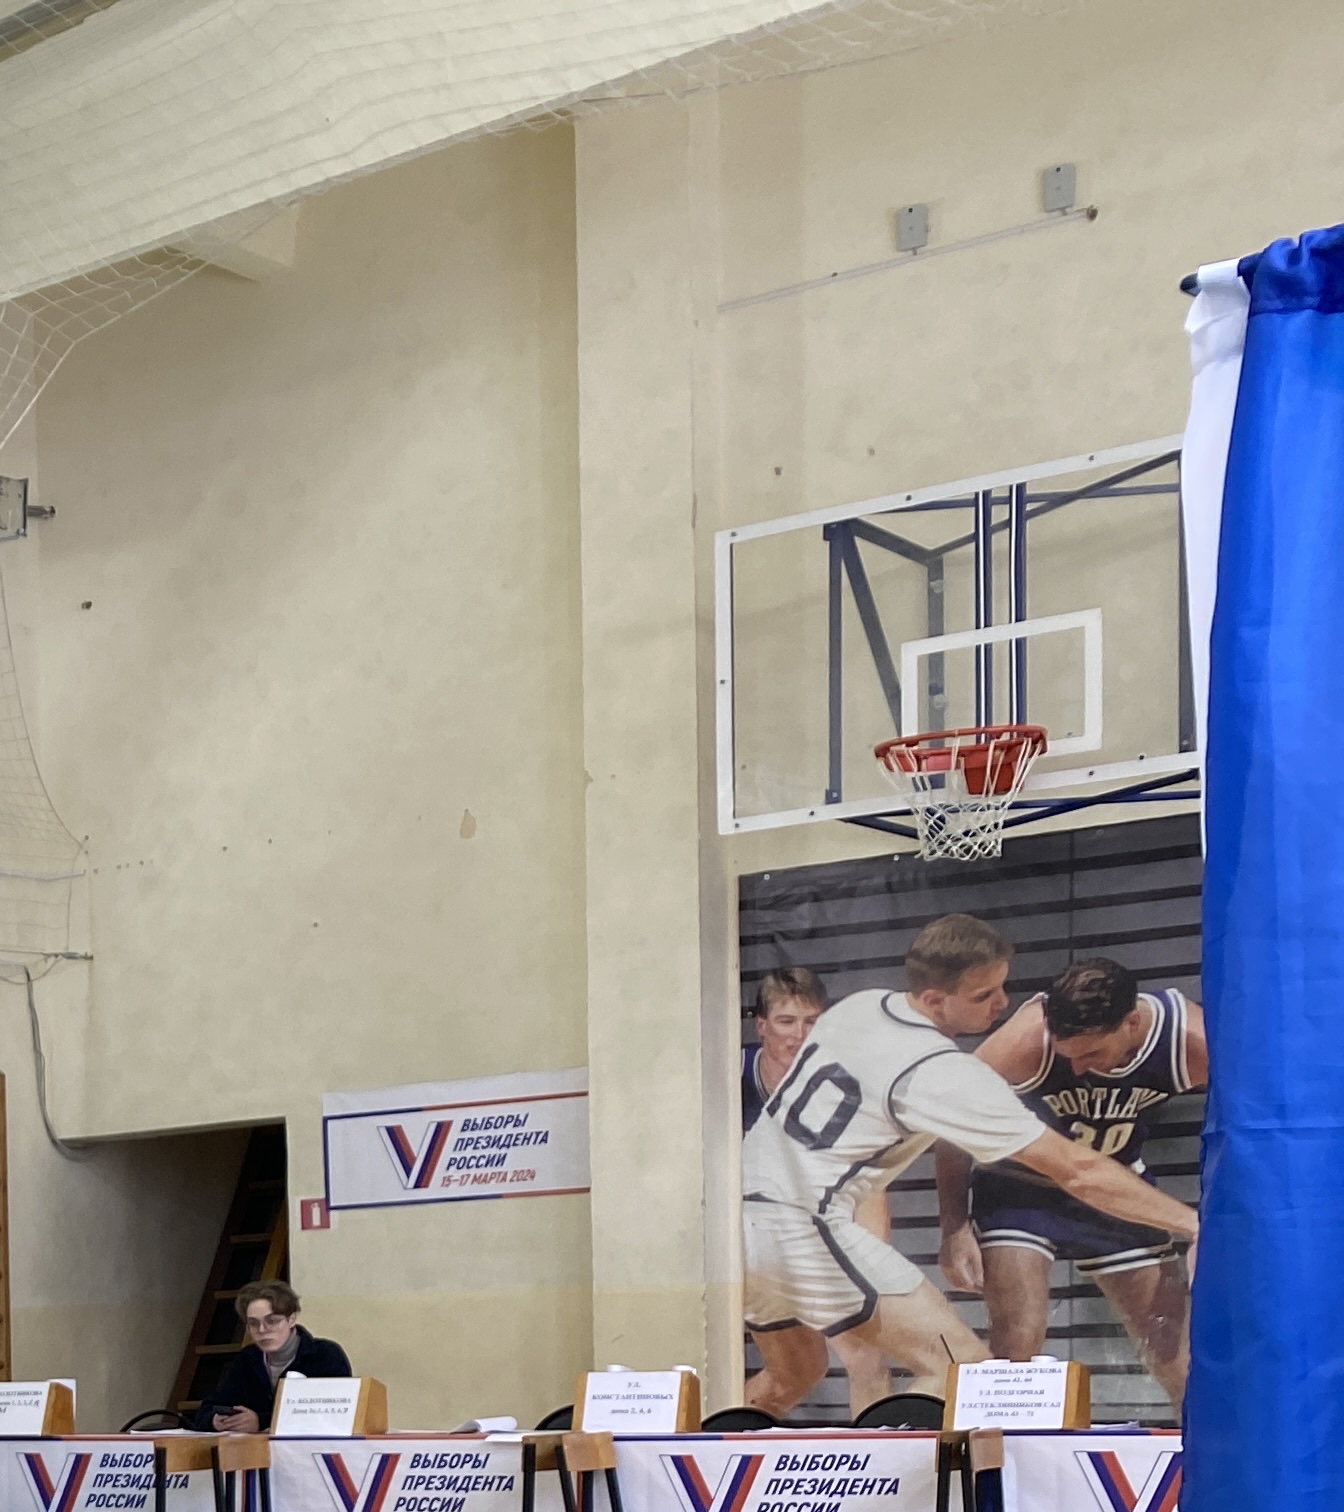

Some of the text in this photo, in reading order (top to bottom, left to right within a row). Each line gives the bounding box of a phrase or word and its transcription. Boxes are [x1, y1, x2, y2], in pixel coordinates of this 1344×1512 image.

[460, 1112, 529, 1132] ВЫБОРЫ
[453, 1130, 549, 1151] ПРЕЗИДЕНТА
[446, 1153, 507, 1171] РОССИИ
[470, 1171, 508, 1185] МАРТА
[509, 1169, 536, 1183] 2024
[99, 1453, 155, 1469] ВЫБОР
[409, 1453, 490, 1469] ВЫБОРЫ
[775, 1454, 871, 1472] ВЫБОРЫ
[93, 1474, 190, 1491] ПРЕЗИДНТА
[401, 1475, 515, 1493] ПРЕЗИДЕНТА
[764, 1477, 900, 1498] ПРЕЗИДЕНТА
[85, 1493, 148, 1509] РОССИИ
[394, 1497, 465, 1512] РОССИИ
